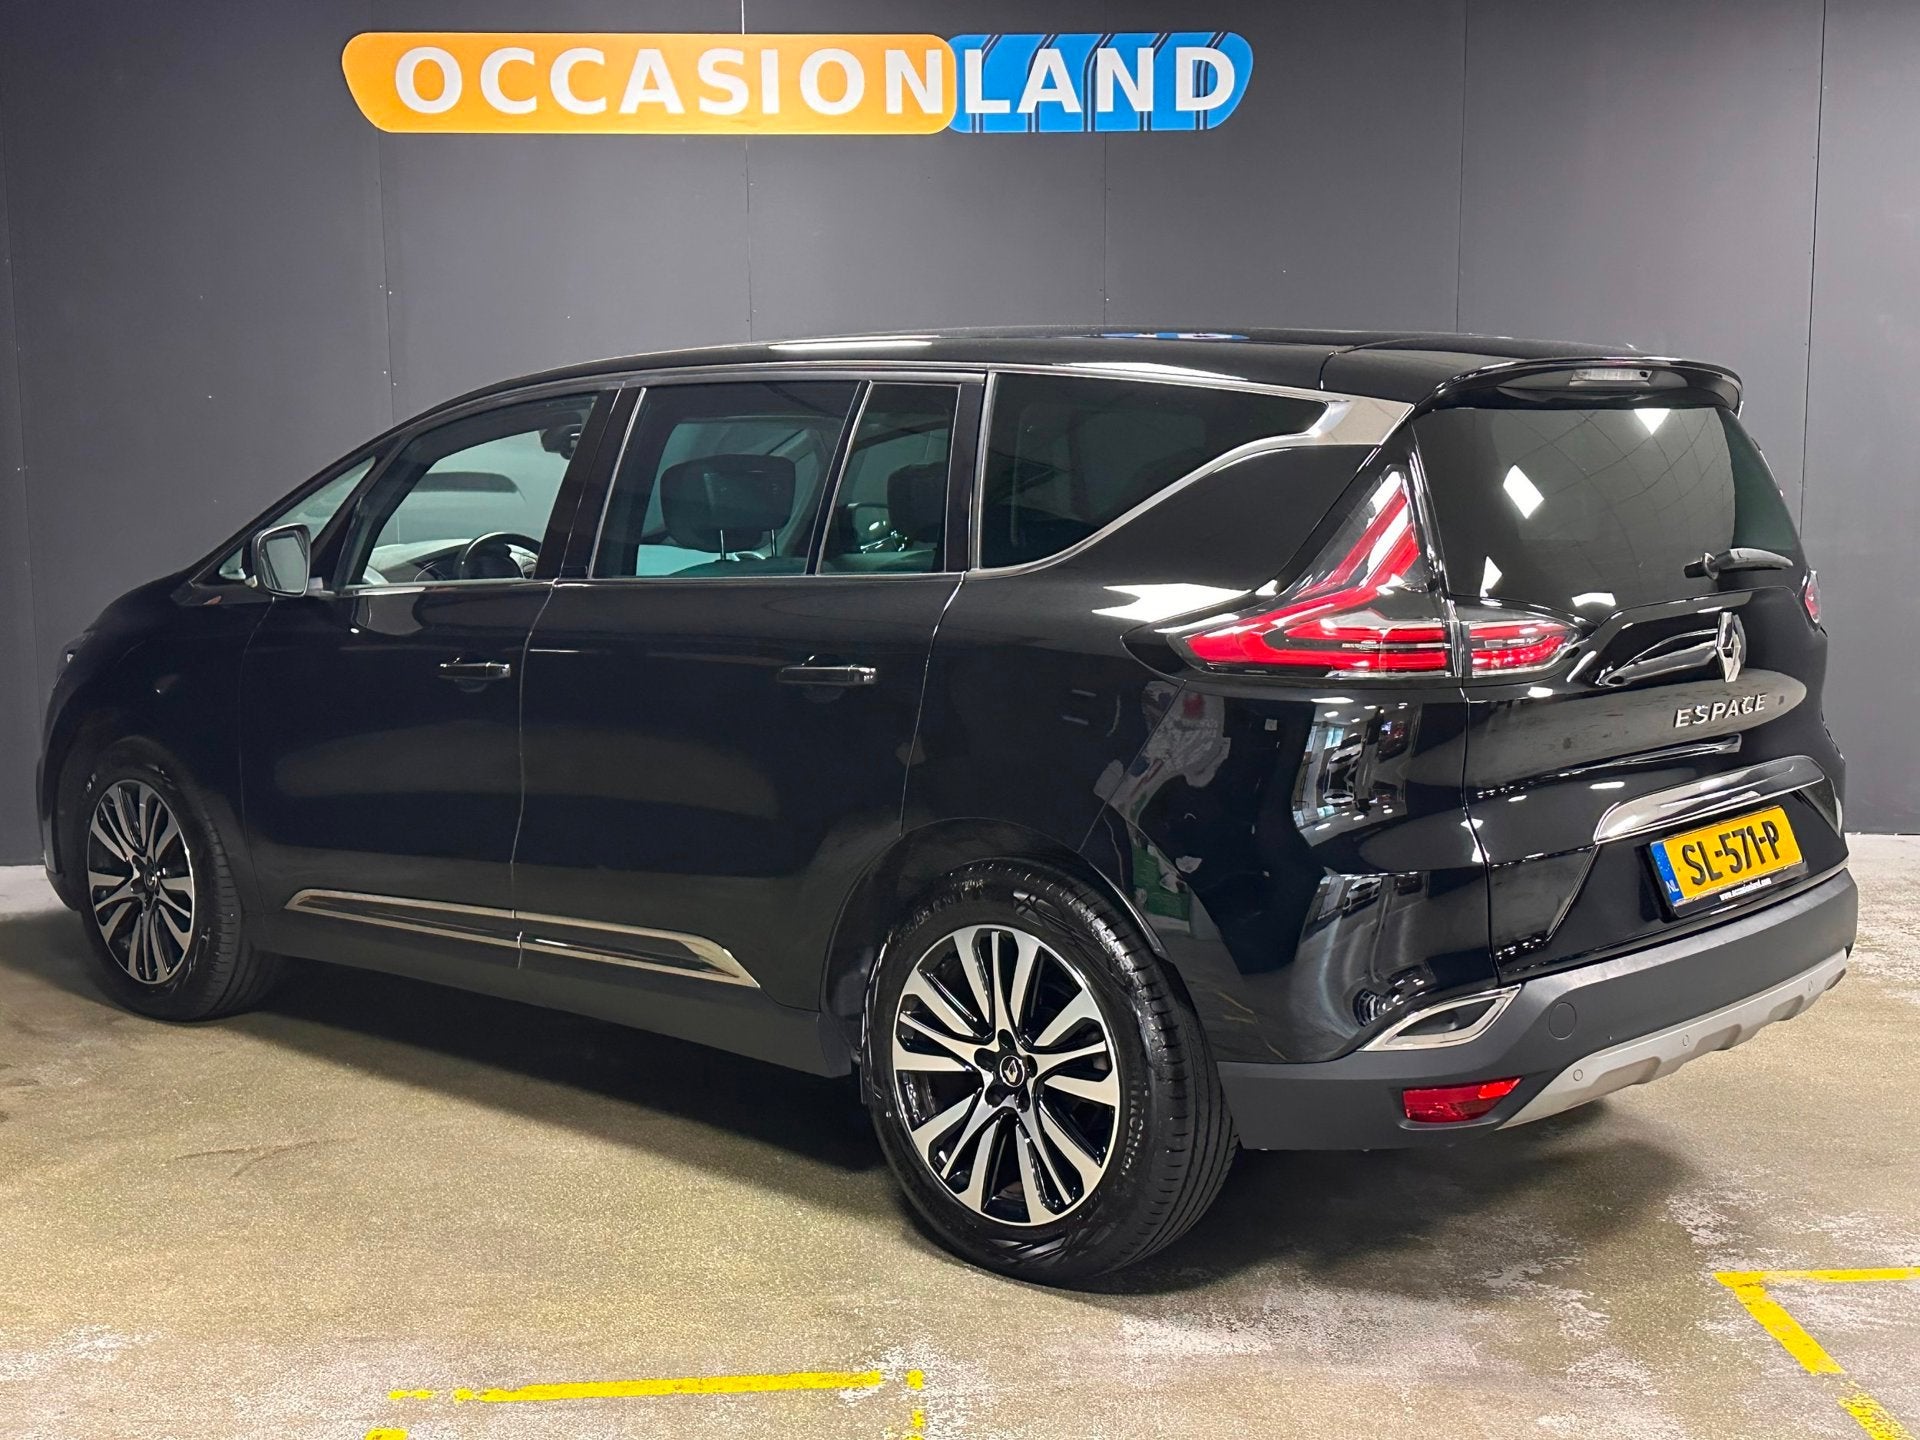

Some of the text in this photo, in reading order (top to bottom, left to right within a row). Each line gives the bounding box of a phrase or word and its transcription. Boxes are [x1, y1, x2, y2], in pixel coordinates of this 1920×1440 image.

[1674, 693, 1768, 728] ESPACE
[1682, 820, 1780, 885] SL-571-P
[1665, 878, 1679, 894] NL
